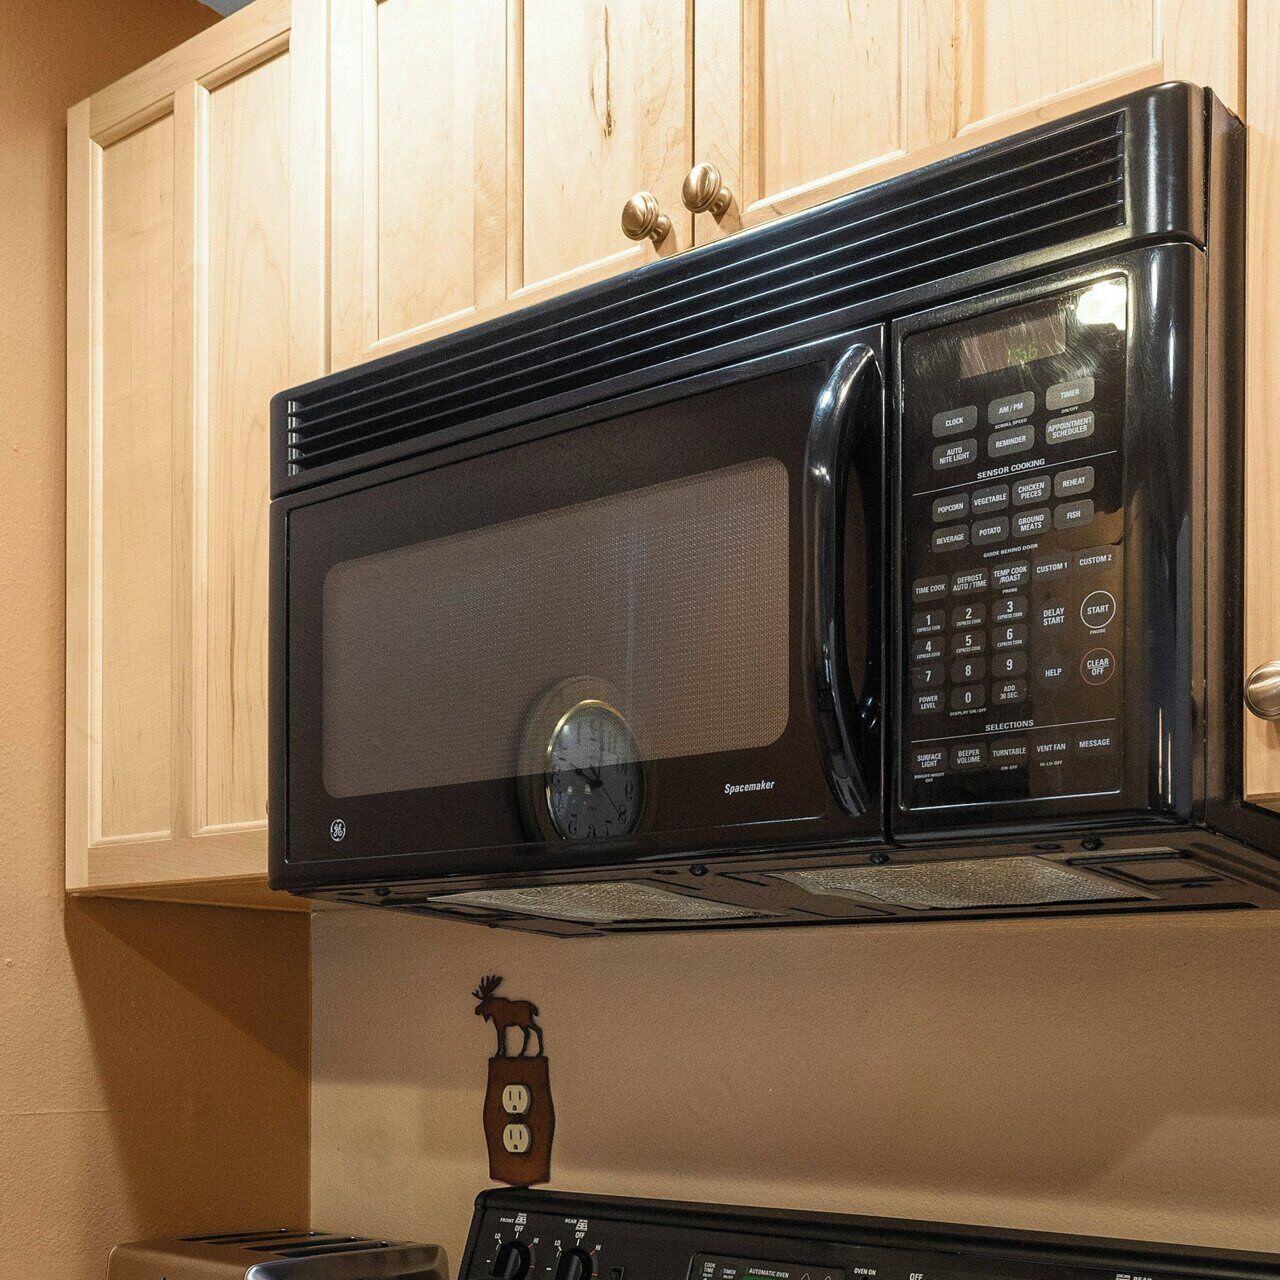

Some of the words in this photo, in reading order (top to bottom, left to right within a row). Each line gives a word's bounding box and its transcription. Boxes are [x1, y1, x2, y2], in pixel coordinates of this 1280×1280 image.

[1060, 389, 1079, 399] TIMER
[999, 406, 1009, 414] AM
[1013, 402, 1023, 411] PM
[945, 417, 964, 427] CLOCK
[1013, 418, 1027, 426] SPEED
[1048, 417, 1092, 433] APPOINTMENT
[1052, 425, 1087, 438] SCHEDULER
[996, 435, 1026, 448] REMINDER
[947, 447, 962, 456] AUTO
[940, 455, 952, 464] NITE
[953, 452, 970, 462] LIGHT
[977, 466, 1009, 479] SENSOR
[1011, 458, 1045, 471] COOKING
[1063, 477, 1085, 487] REHEAT
[1018, 482, 1044, 493] CHICKEN
[974, 493, 1007, 506] VEGETABLE
[1021, 490, 1042, 500] PIECES
[937, 503, 964, 514] POPCORN
[1066, 510, 1081, 519] FISH
[1018, 515, 1044, 525] GROUND
[979, 526, 1001, 536] POTATO
[1021, 522, 1042, 532] MEATS
[937, 533, 964, 545] BEVERAGE
[983, 550, 999, 558] GUIDE
[1001, 546, 1021, 555] BEHIND
[1080, 555, 1107, 566] CUSTOM
[993, 569, 1010, 578] TEMP
[1011, 565, 1027, 574] COOK
[1036, 563, 1064, 574] CUSTOM
[957, 574, 982, 584] DEFROST
[999, 574, 1021, 584] /ROAST
[915, 587, 929, 595] TIME
[930, 584, 946, 592] COOK
[953, 583, 968, 592] AUTO
[972, 580, 987, 588] TIME
[1007, 601, 1013, 612] 3
[1087, 605, 1109, 615] START
[965, 608, 972, 619] 2
[1043, 607, 1064, 617] DELAY
[926, 615, 931, 625] 1
[1043, 616, 1064, 626] START
[1006, 628, 1013, 640] 6
[965, 635, 972, 646] 5
[926, 641, 931, 651] 4
[1006, 659, 1013, 670] 9
[1087, 658, 1109, 668] CLEAR
[965, 665, 972, 676] 8
[1045, 668, 1062, 677] HELP
[1091, 668, 1104, 676] OFF
[926, 671, 931, 682] 7
[919, 695, 938, 703] POWER
[965, 692, 971, 703] 0
[985, 720, 1034, 731] SELECTIONS
[1037, 745, 1053, 753] VENT
[1054, 743, 1066, 751] FAN
[1079, 739, 1111, 748] MESSAGE
[917, 753, 942, 761] SURFACE
[958, 749, 980, 758] BEEPER
[993, 747, 1026, 757] TURNTABLE
[921, 760, 938, 768] LIGHT
[956, 755, 981, 764] VOLUME
[724, 780, 775, 795] Spacemaker
[749, 1268, 776, 1277] AUTOMATIC
[854, 1267, 868, 1275] OVEN
[909, 1273, 923, 1280] OFF
